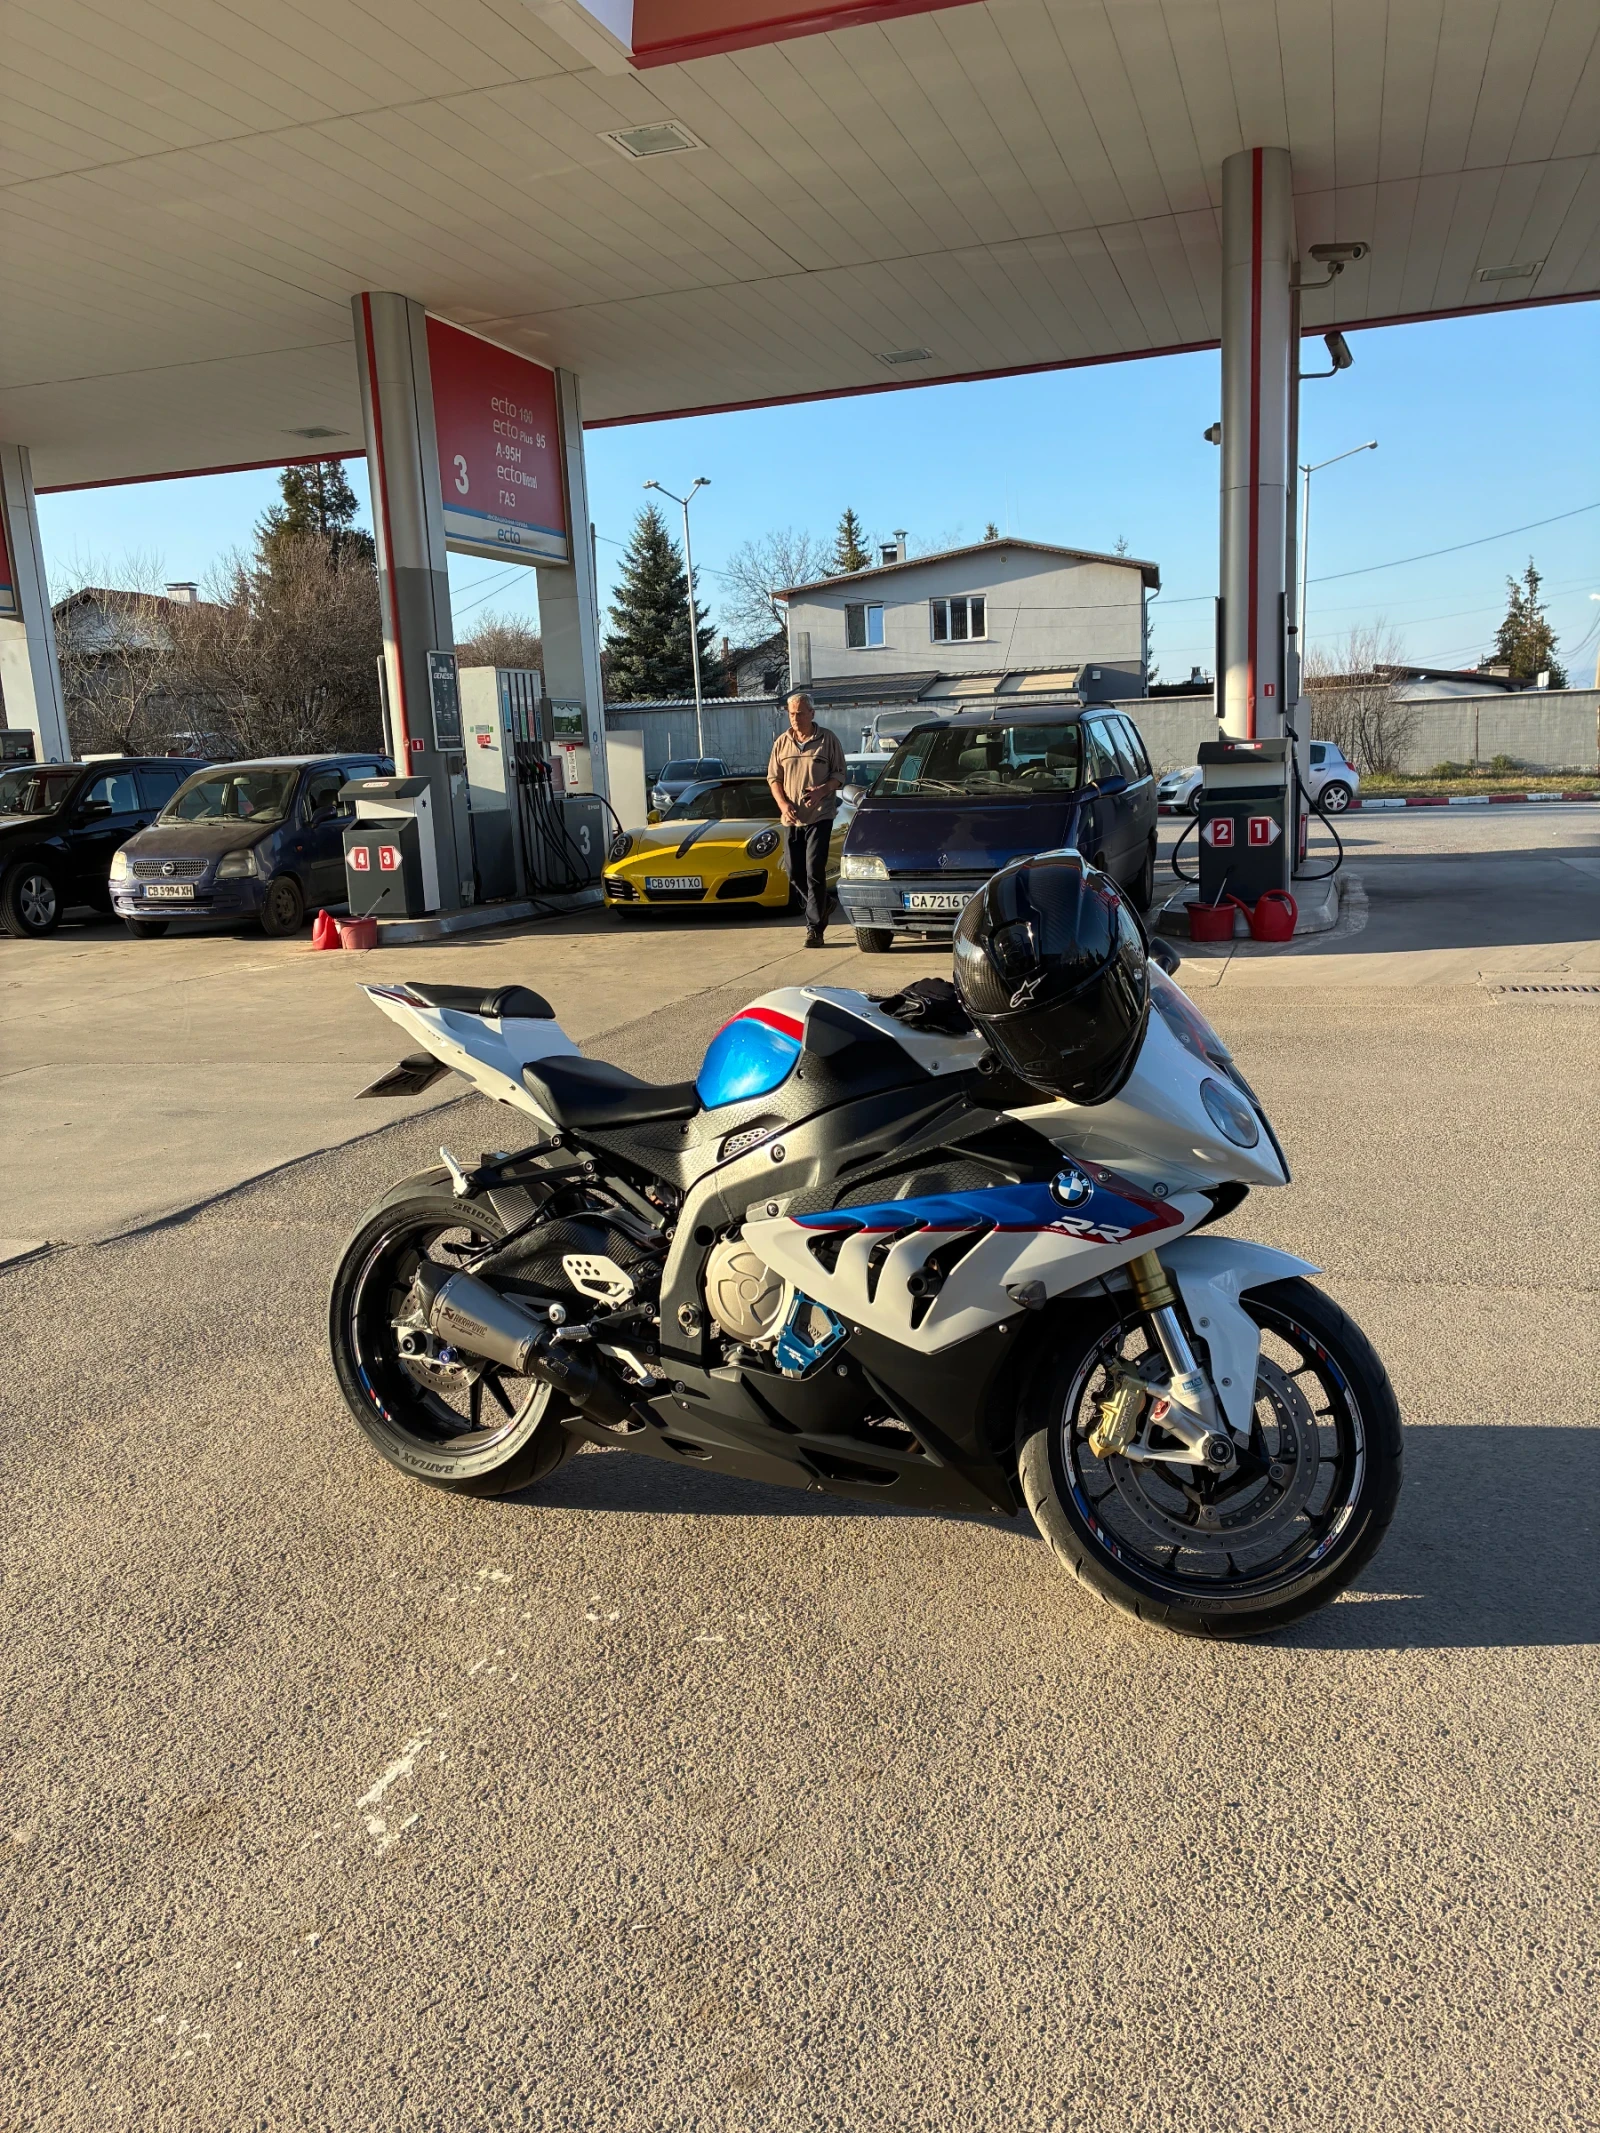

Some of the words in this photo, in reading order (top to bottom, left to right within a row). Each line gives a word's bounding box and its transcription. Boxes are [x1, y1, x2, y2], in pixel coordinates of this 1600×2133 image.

[491, 396, 517, 418] ecto
[519, 407, 533, 424] 100
[493, 419, 519, 439] ecto
[520, 430, 533, 445] Plus
[536, 432, 546, 449] 95
[454, 454, 469, 495] 3
[499, 489, 516, 507] ГАЗ
[497, 526, 521, 544] ecto
[433, 672, 455, 680] GENESIS
[1216, 823, 1229, 840] 2
[1254, 823, 1262, 839] 1
[579, 825, 591, 855] 3
[357, 852, 366, 866] 4
[382, 851, 391, 865] 3
[147, 886, 159, 896] CB
[181, 886, 193, 896] XH
[651, 878, 664, 889] CB
[664, 878, 686, 889] 0911
[687, 877, 701, 888] XO
[911, 895, 928, 908] CA
[929, 895, 960, 908] 7216
[1057, 1170, 1090, 1187] BMW
[1050, 1215, 1132, 1244] RR
[402, 1452, 455, 1475] BATTLAX
